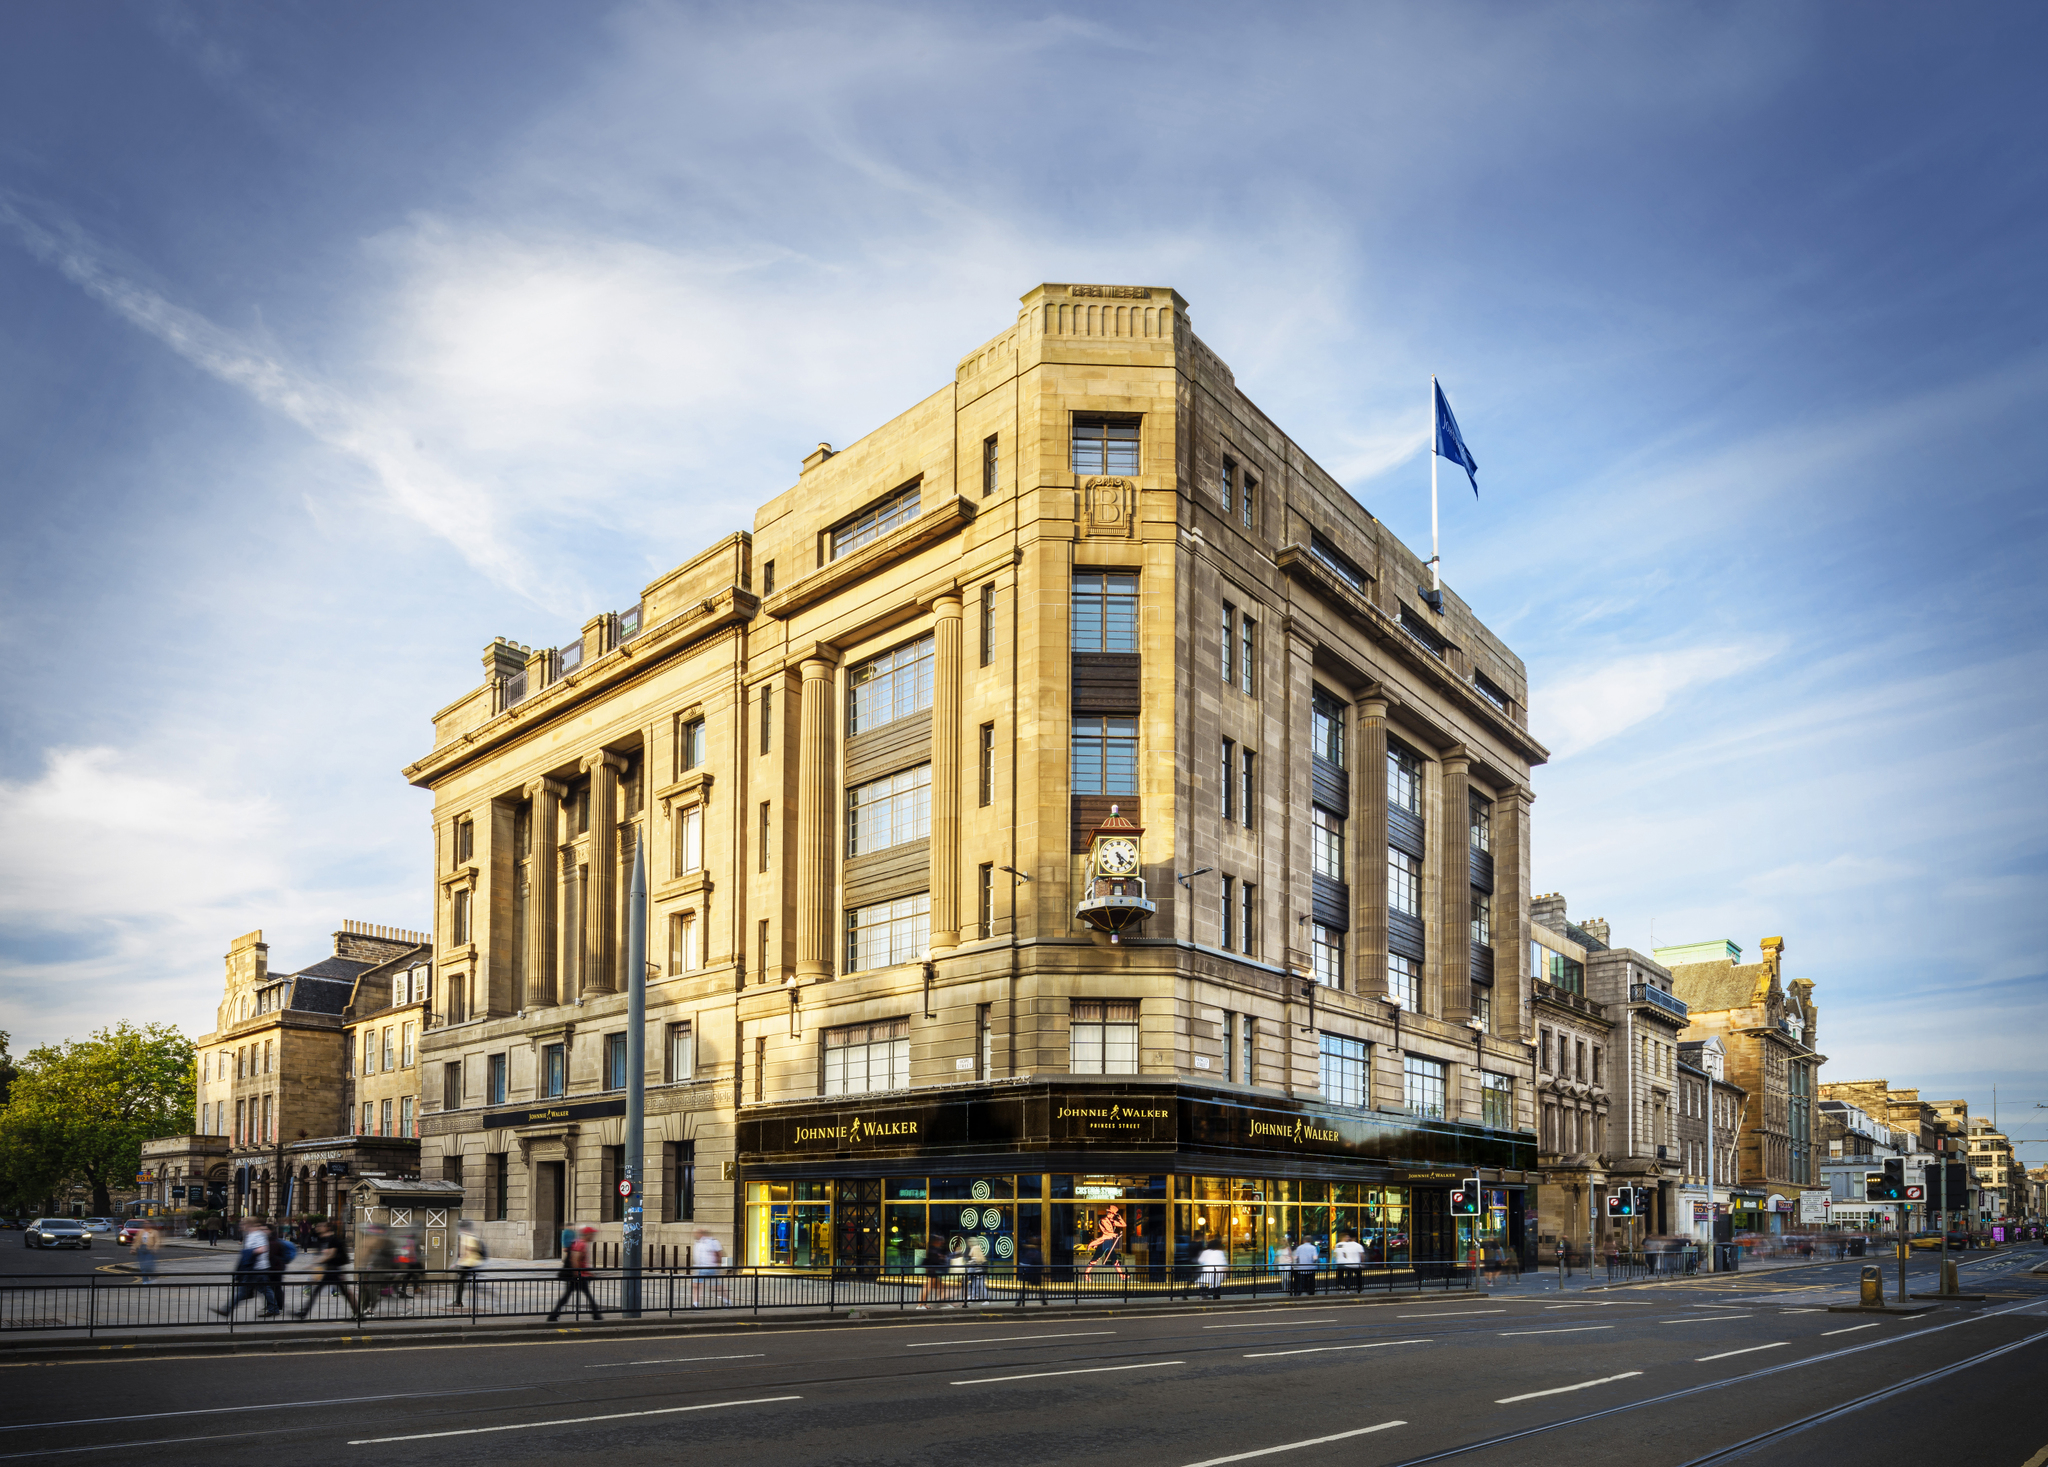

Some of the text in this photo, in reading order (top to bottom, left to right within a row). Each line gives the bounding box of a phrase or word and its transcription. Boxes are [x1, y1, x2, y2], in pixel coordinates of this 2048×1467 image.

[1057, 1107, 1169, 1119] JOHNNIE WALKER
[794, 1121, 918, 1144] JOHNNIE WALKER
[1248, 1119, 1339, 1142] JOHNNIE WALKER
[620, 1184, 630, 1192] 20
